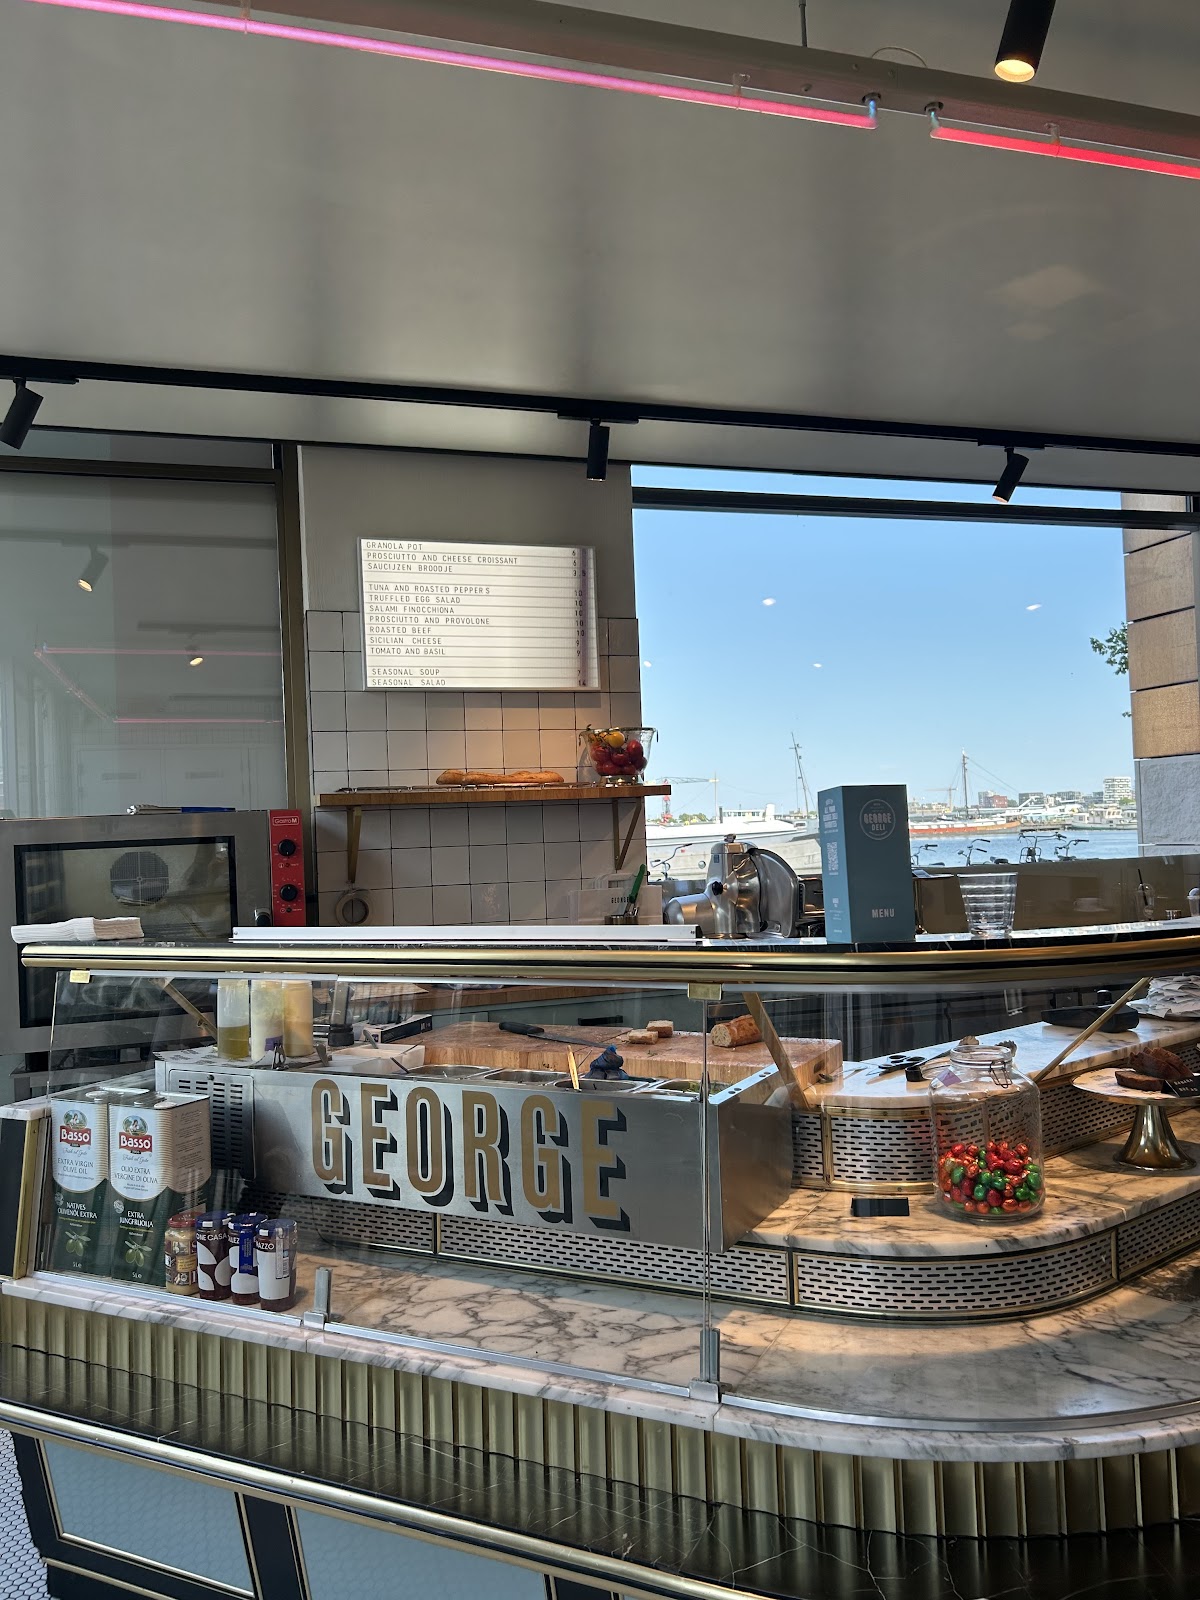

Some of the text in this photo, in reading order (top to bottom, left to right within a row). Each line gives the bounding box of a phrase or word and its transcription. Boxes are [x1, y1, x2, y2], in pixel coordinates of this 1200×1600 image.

[367, 542, 403, 550] GRANOLA
[367, 553, 416, 561] PROSCIUTTO
[478, 556, 518, 564] CROISSANT
[368, 563, 412, 571] SAUCIJZEN
[404, 606, 454, 614] FINOCCHIONA
[370, 616, 419, 624] PROSCIUTTO
[372, 668, 413, 676] SEASONAL
[864, 813, 892, 824] GEORGE
[872, 908, 895, 918] MENU
[62, 1129, 90, 1142] Basso
[121, 1135, 151, 1149] Basso
[311, 1079, 630, 1232] GEORGE
[58, 1158, 94, 1168] EXTRA VIRGIN
[63, 1166, 78, 1174] OLIVE
[134, 1167, 150, 1175] EXTRA
[114, 1173, 136, 1182] VERGINE
[142, 1176, 158, 1184] OLIVA
[66, 1202, 86, 1210] NATIVES
[80, 1210, 97, 1219] EXTRA
[127, 1211, 145, 1219] EXTRA
